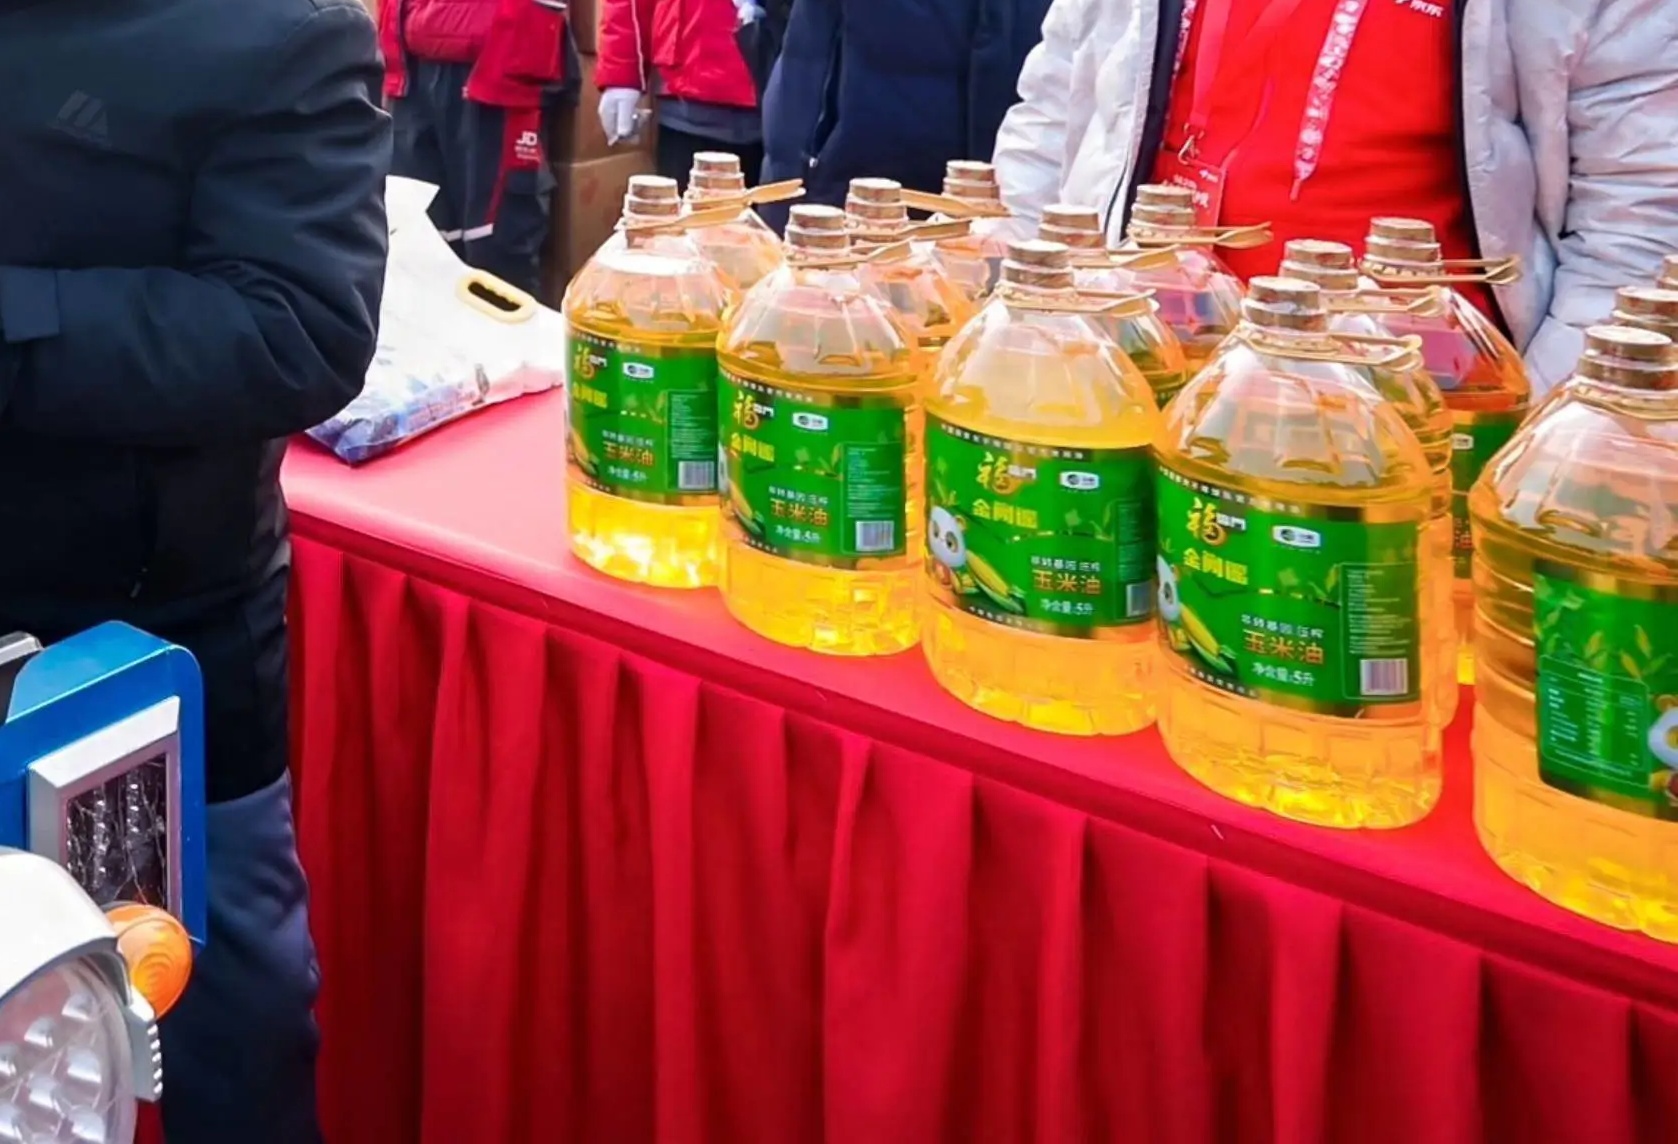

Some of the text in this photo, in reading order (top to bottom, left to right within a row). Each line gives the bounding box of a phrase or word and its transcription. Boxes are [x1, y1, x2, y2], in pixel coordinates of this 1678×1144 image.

[516, 131, 537, 145] JD
[1032, 568, 1102, 594] 玉米油
[1243, 629, 1324, 664] 玉米油
